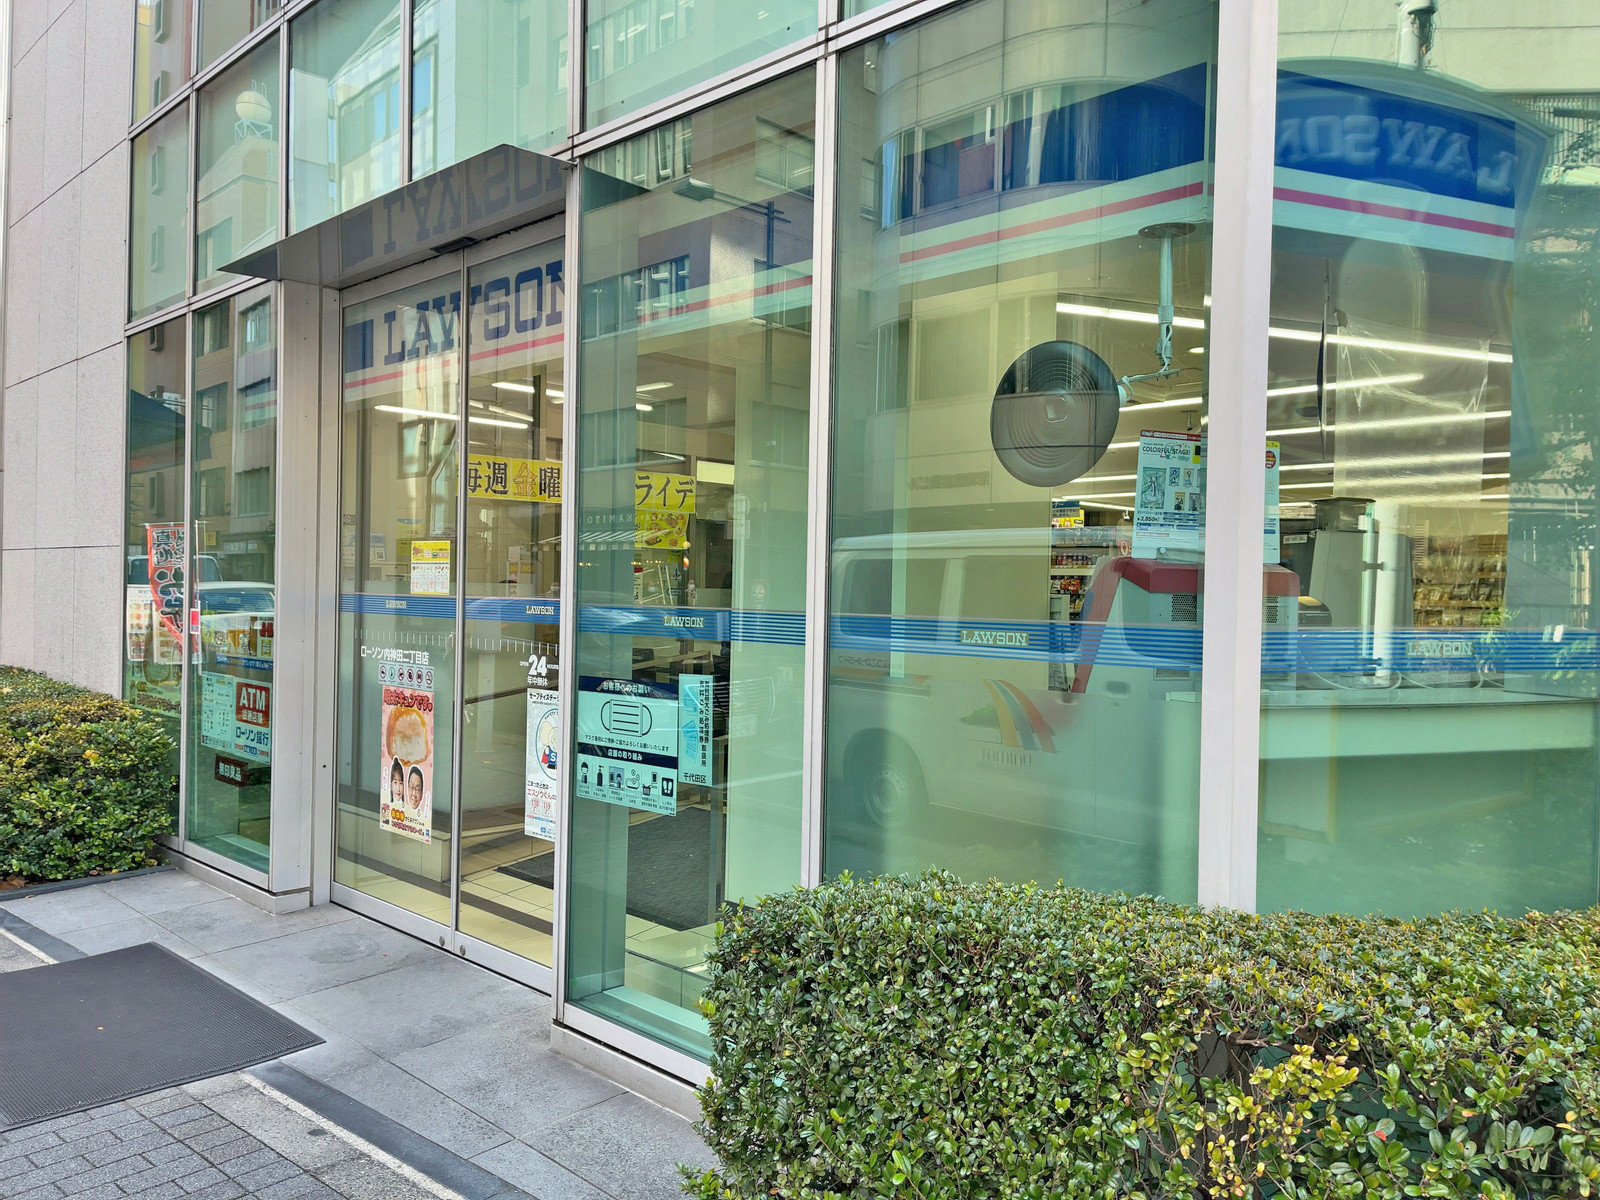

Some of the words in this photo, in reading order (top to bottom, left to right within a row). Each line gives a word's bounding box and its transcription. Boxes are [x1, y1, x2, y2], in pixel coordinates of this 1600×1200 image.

[385, 600, 407, 609] LAWSON
[526, 605, 554, 615] LAWSON
[664, 616, 704, 628] LAWSON
[961, 630, 1028, 647] LAWSON
[1407, 641, 1473, 656] LAWSON
[528, 654, 547, 676] 24
[240, 686, 266, 712] ATM
[235, 726, 269, 747] ローソン銀行
